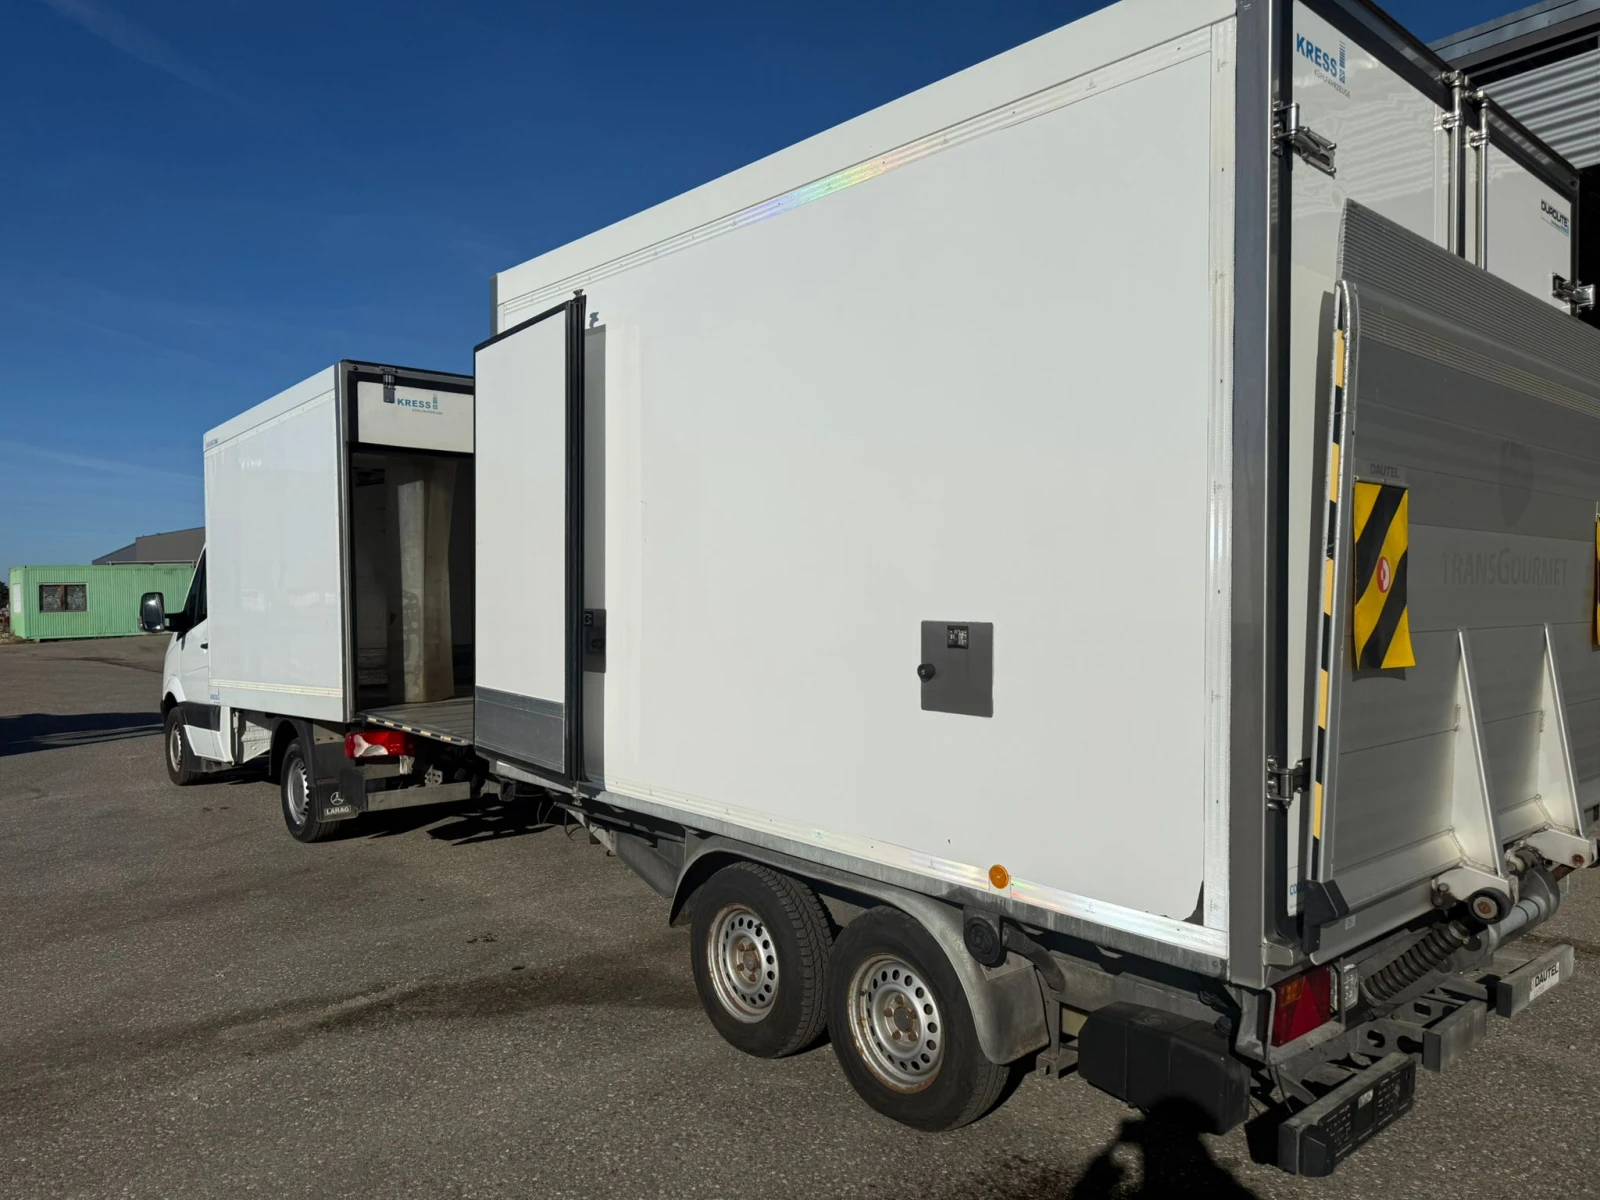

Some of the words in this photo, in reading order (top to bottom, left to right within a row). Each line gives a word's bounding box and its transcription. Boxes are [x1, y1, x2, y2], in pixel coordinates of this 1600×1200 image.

[1296, 32, 1338, 78] KRESS
[397, 398, 431, 409] KRESS
[1370, 462, 1399, 479] DAUTEL
[1534, 964, 1559, 987] DAUTEL
